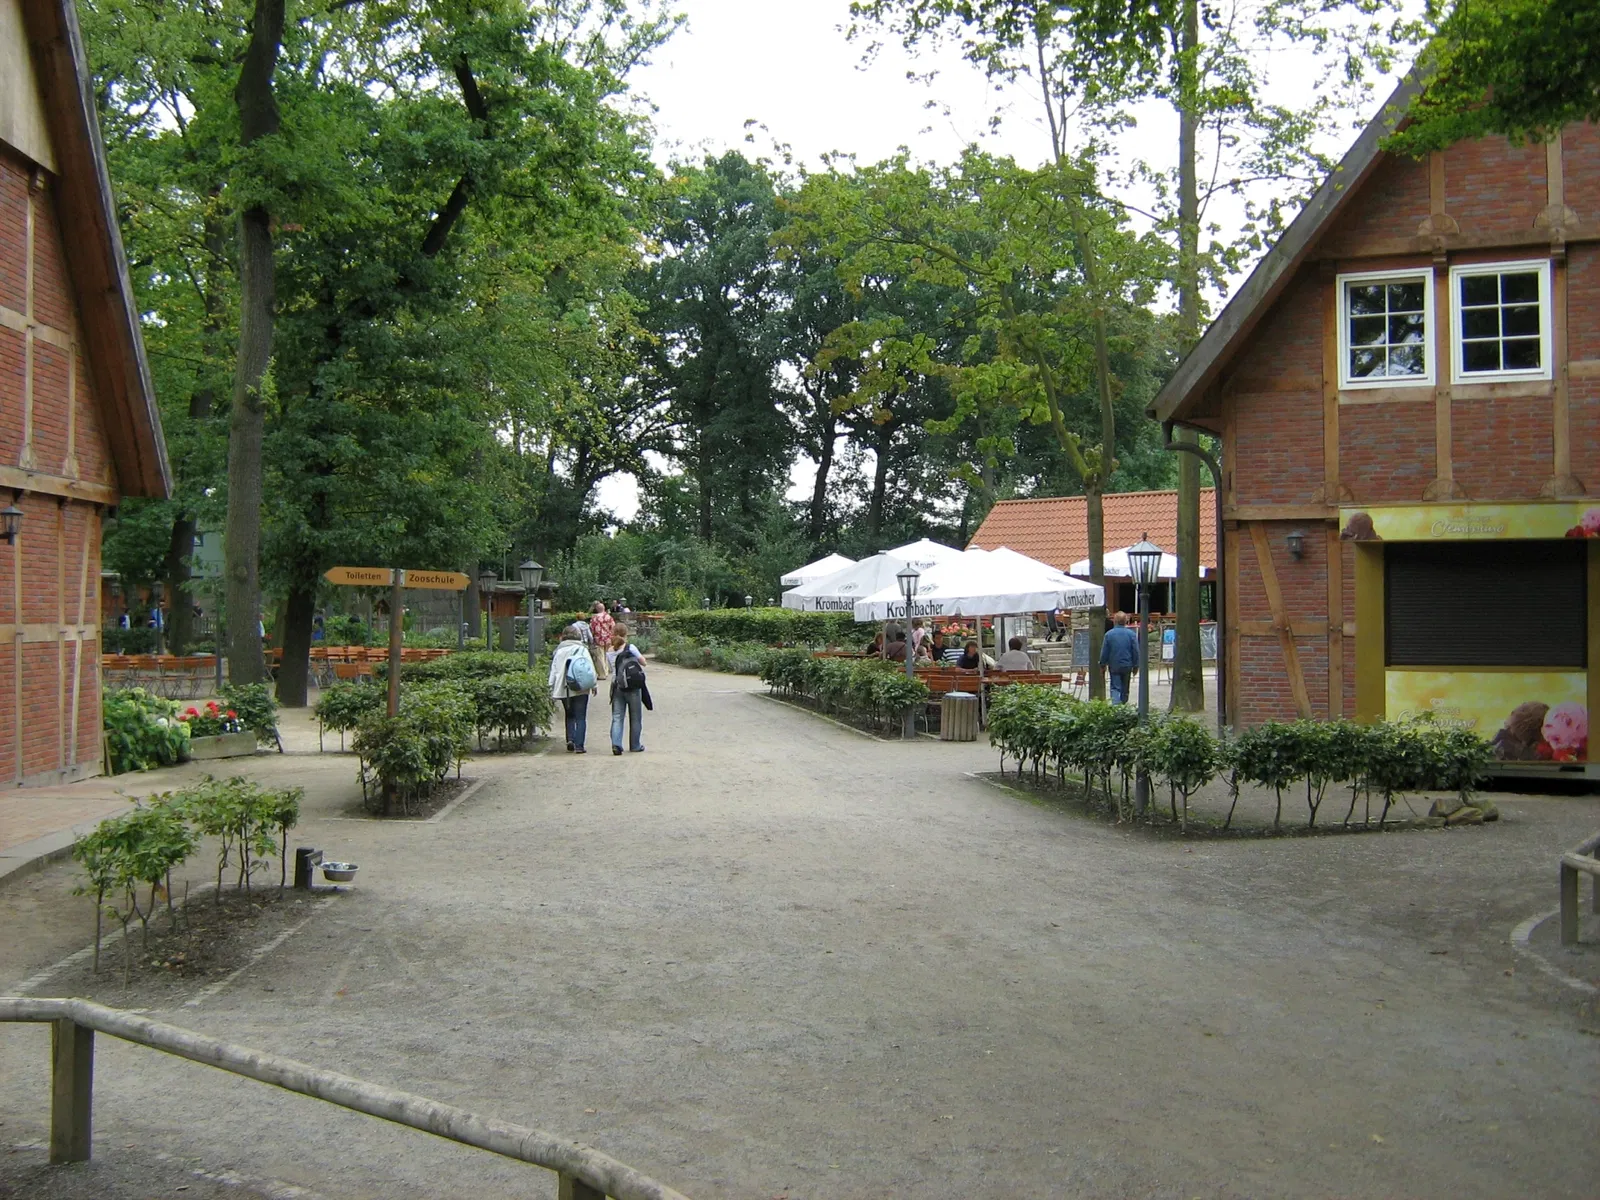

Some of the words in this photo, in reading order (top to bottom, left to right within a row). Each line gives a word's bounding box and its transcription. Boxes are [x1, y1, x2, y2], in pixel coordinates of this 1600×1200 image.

[345, 571, 382, 580] Toiletten
[409, 573, 455, 584] Zooschule
[1064, 590, 1095, 607] Kombacher
